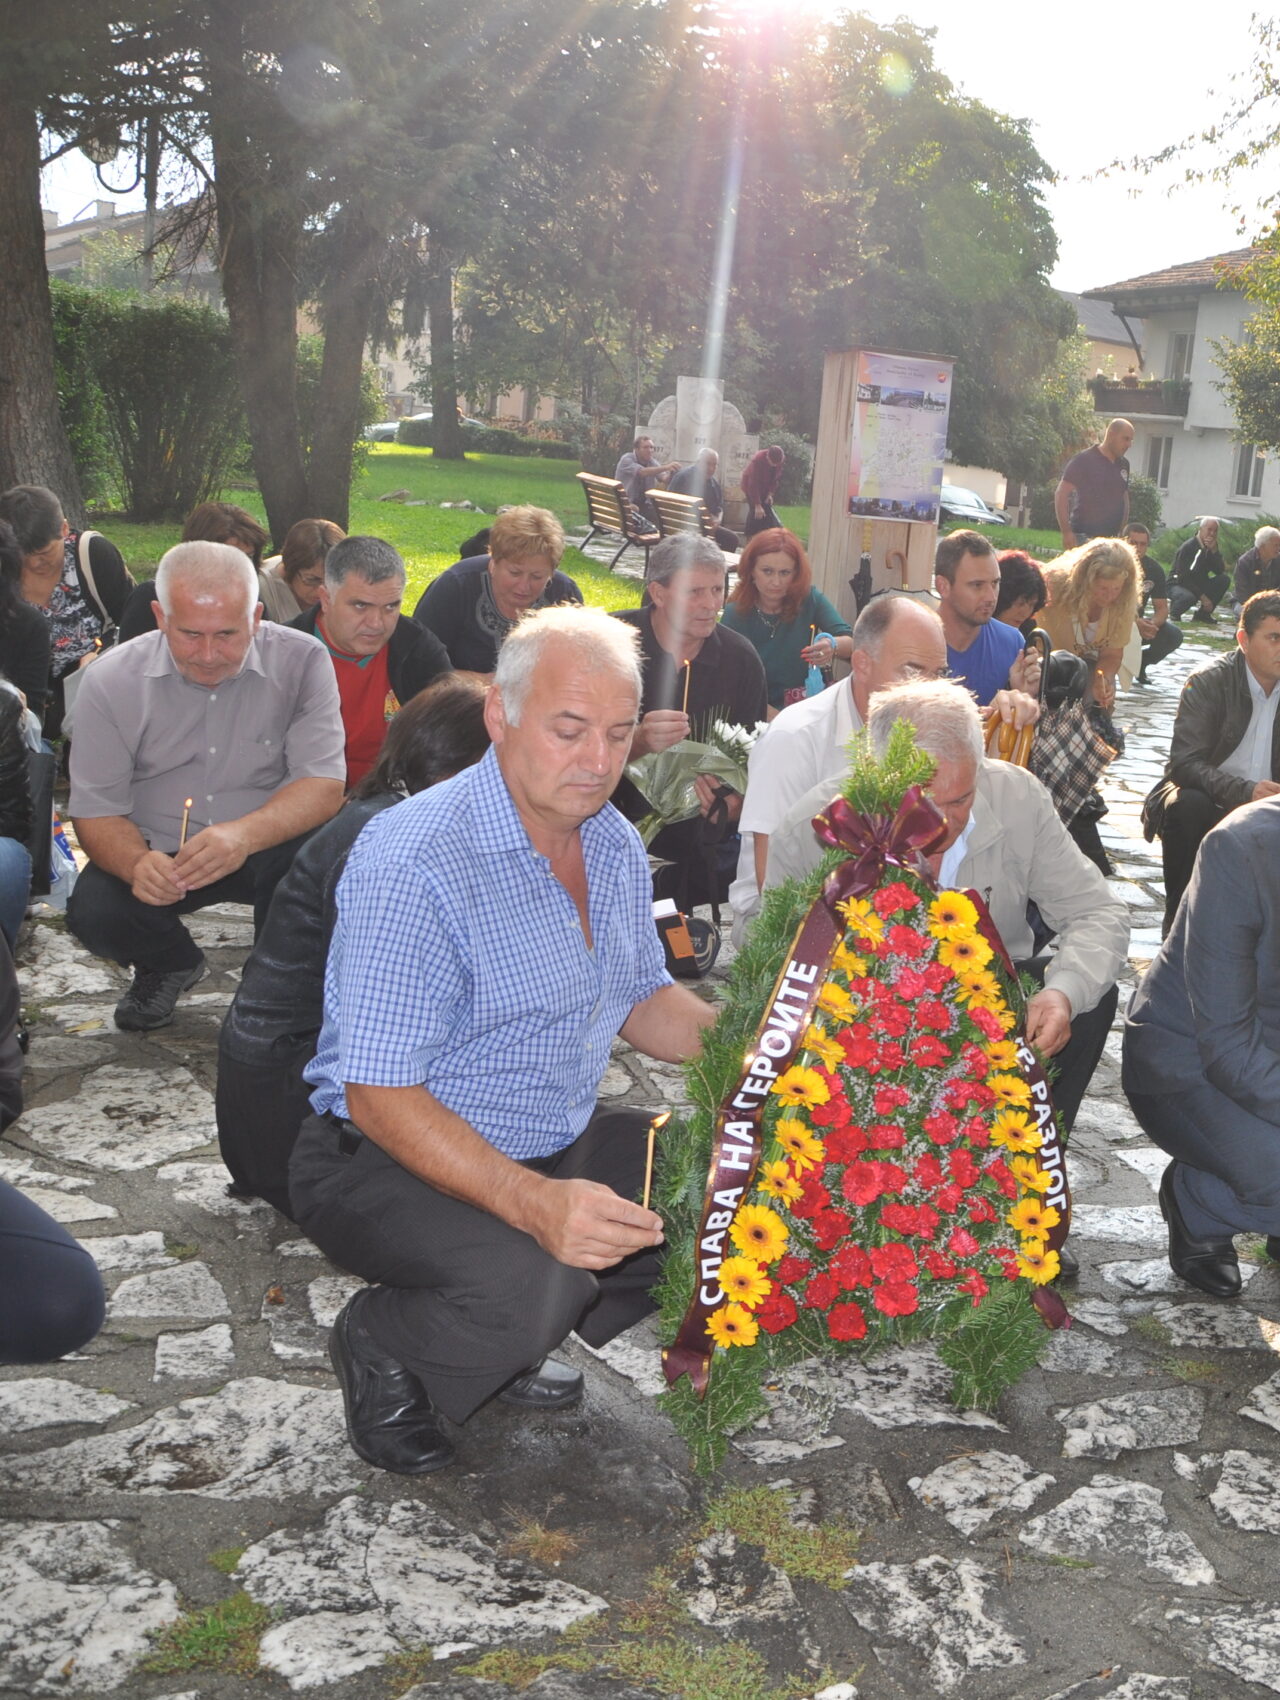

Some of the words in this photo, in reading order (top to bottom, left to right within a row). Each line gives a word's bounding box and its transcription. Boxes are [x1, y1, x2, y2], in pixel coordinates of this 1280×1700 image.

[732, 960, 818, 1110] ГЕРОИТЕ
[719, 1120, 754, 1172] НА
[1031, 1079, 1067, 1211] РАЗЛОГ
[699, 1186, 744, 1306] СЛАВА
